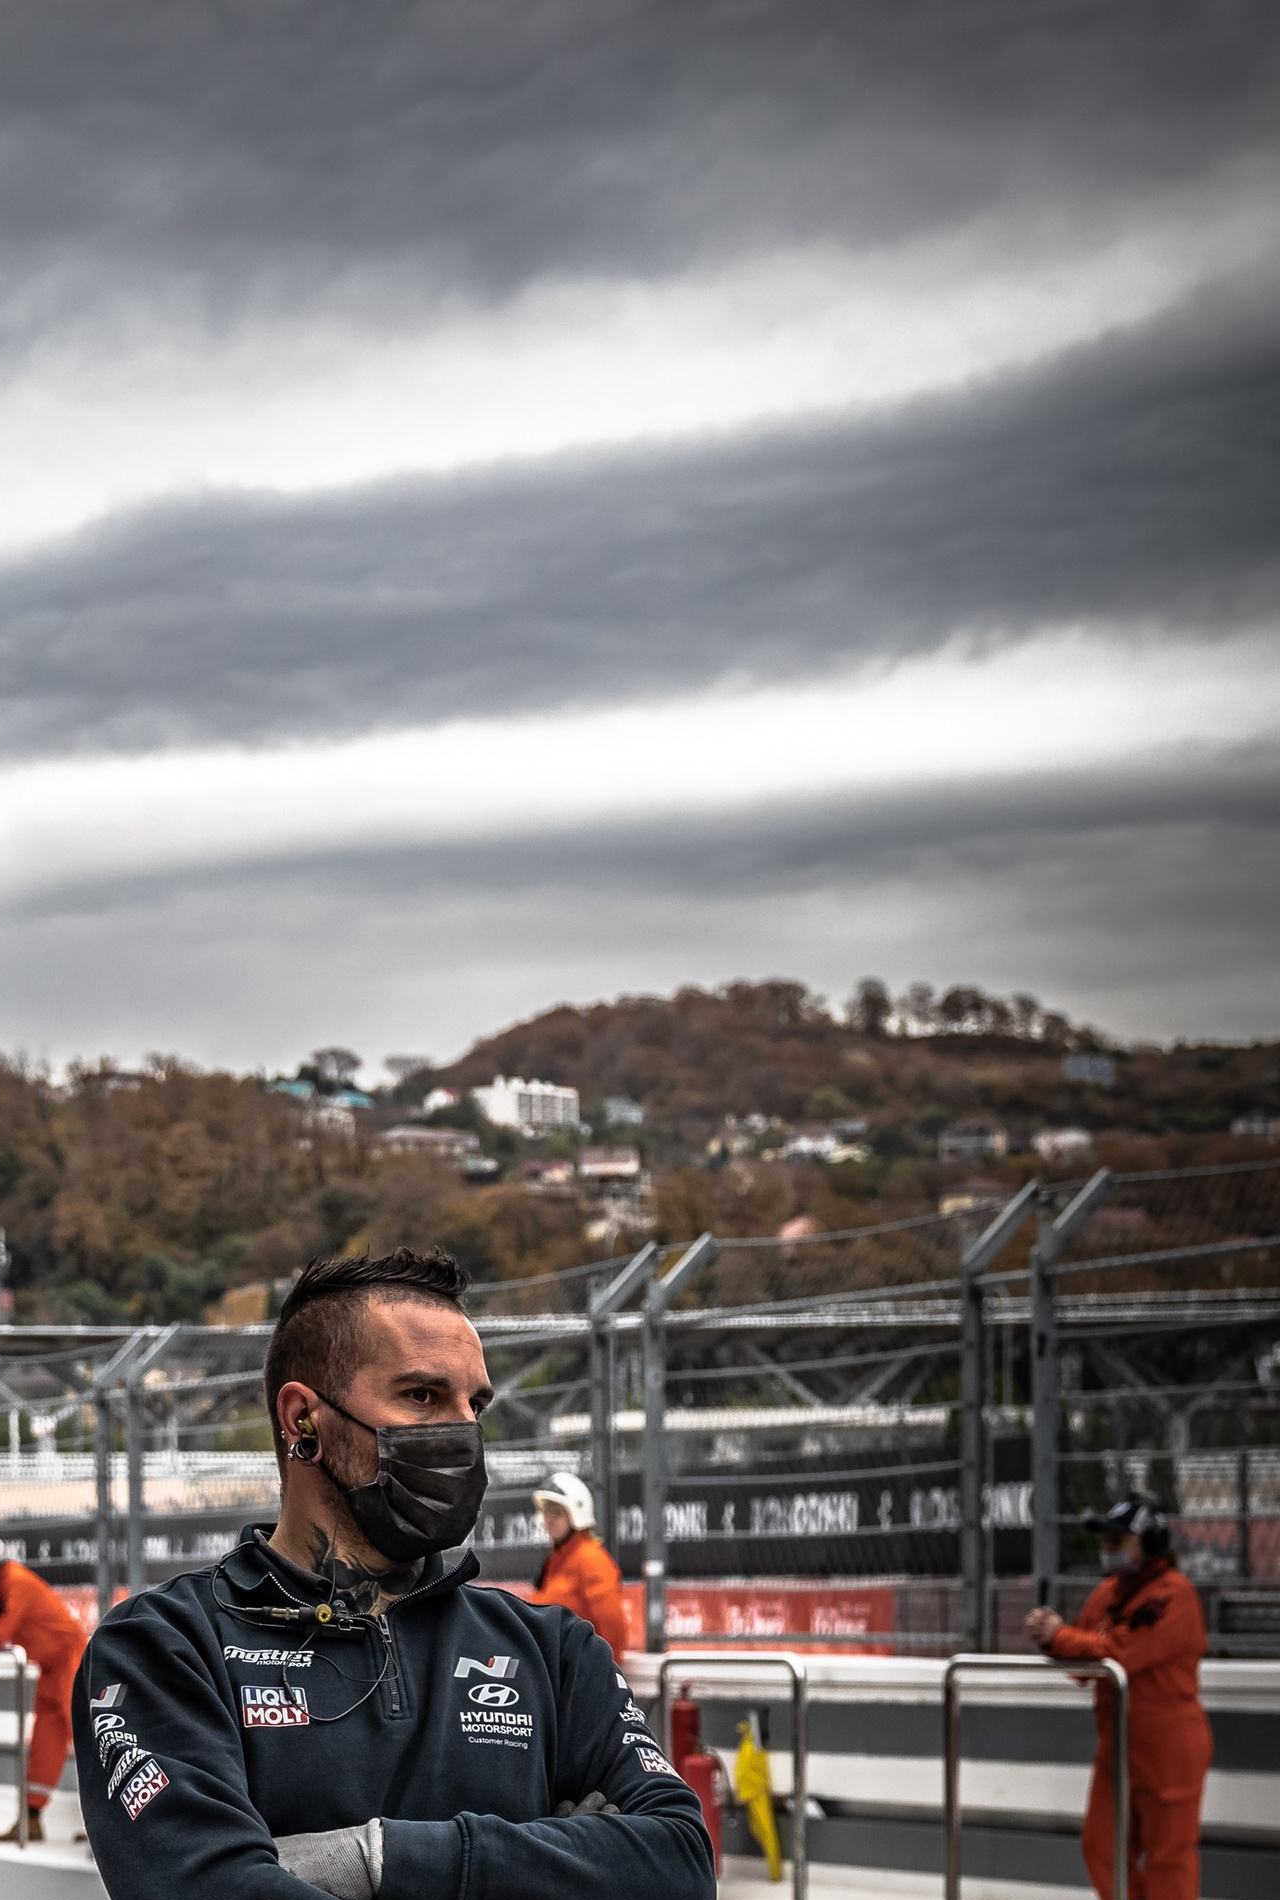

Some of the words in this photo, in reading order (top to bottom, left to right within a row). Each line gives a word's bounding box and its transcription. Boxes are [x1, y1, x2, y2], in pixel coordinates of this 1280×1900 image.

[247, 1706, 305, 1724] MOLY
[460, 1712, 533, 1726] HYUNDAI
[462, 1724, 533, 1736] MOTORSPORT
[468, 1736, 503, 1745] Customer
[504, 1739, 528, 1749] Racing
[123, 1763, 159, 1804] LIQUI
[129, 1773, 165, 1816] MOLY
